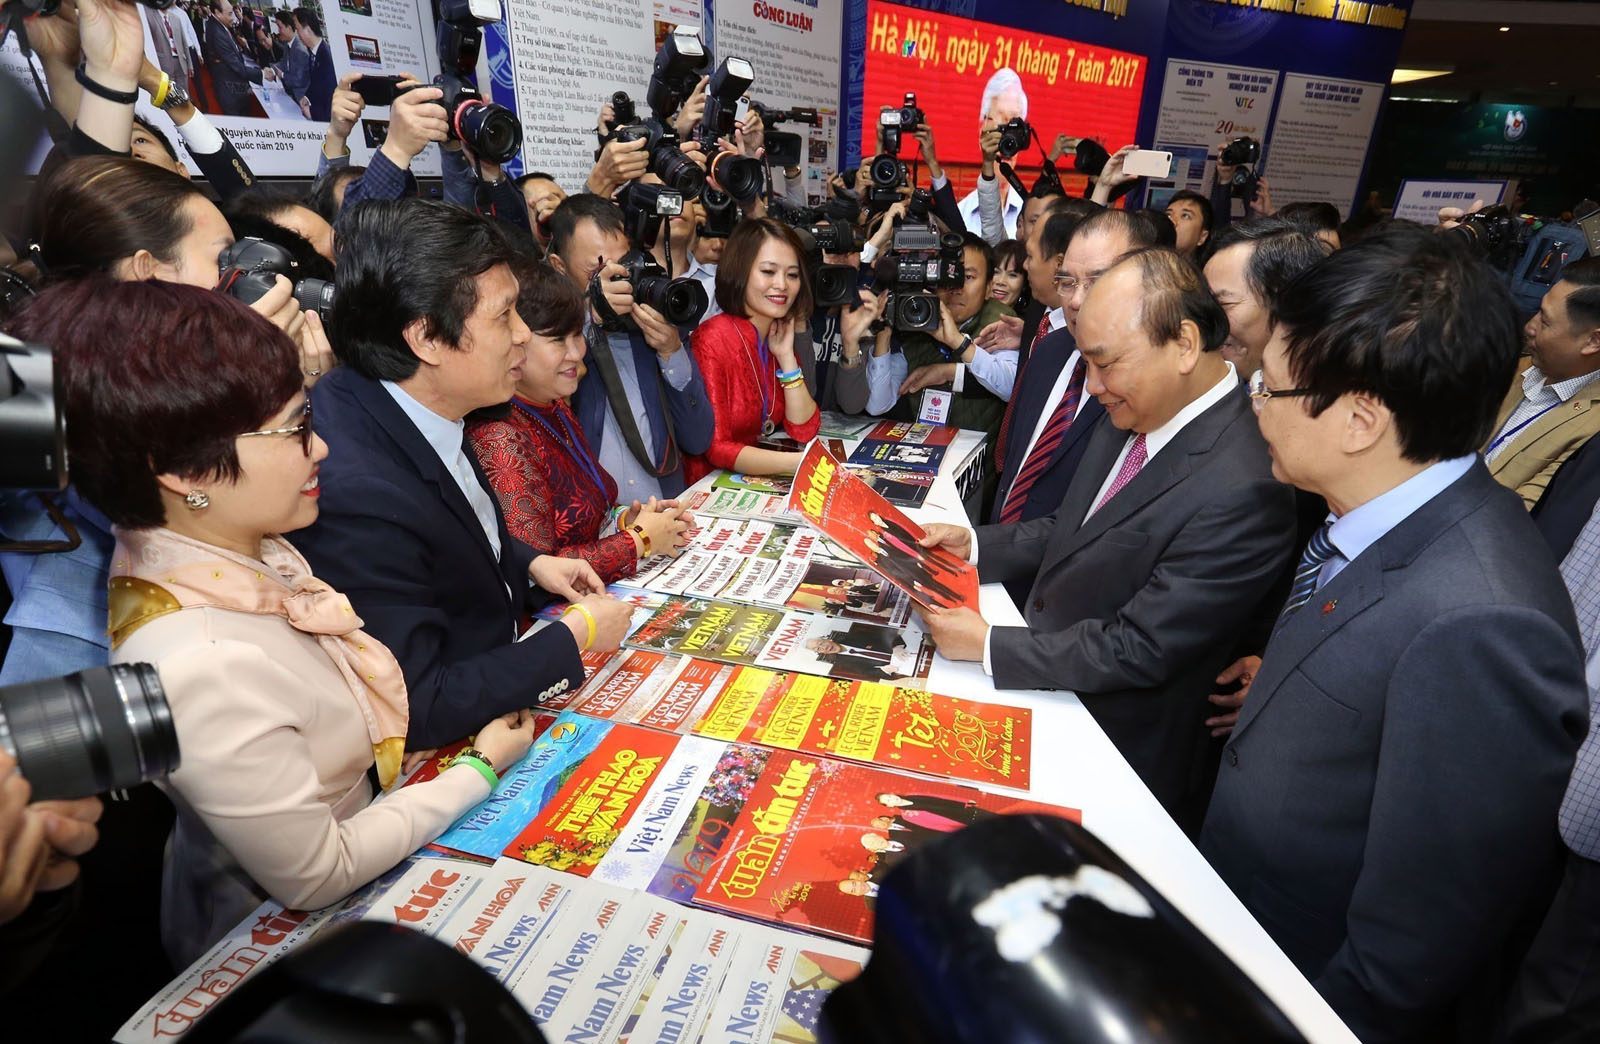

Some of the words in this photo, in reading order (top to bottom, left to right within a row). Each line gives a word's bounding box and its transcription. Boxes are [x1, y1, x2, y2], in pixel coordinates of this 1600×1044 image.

[753, 1, 784, 24] CÔNG
[786, 8, 813, 34] LUẬN
[871, 12, 898, 55] Hà
[904, 16, 940, 68] Nội,
[946, 27, 990, 75] ngày
[992, 36, 1012, 69] 31
[1016, 40, 1060, 85] tháng
[1064, 48, 1076, 78] 7
[1075, 52, 1105, 84] năm
[1107, 56, 1140, 88] 2017
[234, 140, 255, 151] quốc
[256, 142, 273, 150] năm
[275, 142, 294, 150] 2019
[255, 129, 274, 138] Xuân
[276, 130, 295, 140] Phúc
[308, 132, 323, 140] khai
[1215, 120, 1234, 134] 20
[680, 606, 732, 650] VIETNAM
[721, 611, 769, 657] VIETNAM
[763, 618, 807, 662] VIETNAM
[580, 704, 594, 712] LE
[590, 670, 629, 704] COURRIER
[600, 671, 644, 712] VIETNAM
[646, 714, 658, 724] LE
[654, 680, 690, 715] COURRIER
[664, 682, 704, 723] VIETNAM
[705, 726, 716, 734] LE
[714, 688, 742, 727] COURRIER
[720, 690, 758, 732] VIETNAM
[772, 696, 800, 734] COURRIER
[780, 697, 816, 741] VIETNAM
[845, 704, 867, 745] COURRIER
[854, 706, 882, 751] VIETNAM
[768, 733, 780, 742] LE
[840, 744, 852, 752] LE
[460, 806, 502, 832] Việt
[488, 778, 528, 808] Nam
[516, 748, 558, 777] News
[587, 749, 638, 796] THAO
[626, 826, 664, 852] Việt
[645, 796, 680, 827] Nam
[664, 764, 698, 796] News
[394, 869, 460, 924] tức
[538, 882, 562, 912] ANN
[799, 883, 813, 902] 2019
[596, 900, 620, 929] ANN
[646, 912, 667, 940] ANN
[484, 914, 538, 966] News
[547, 932, 598, 984] News
[708, 930, 727, 958] ANN
[766, 945, 784, 974] ANN
[595, 944, 646, 998] News
[662, 963, 710, 1018] News
[724, 980, 770, 1038] News
